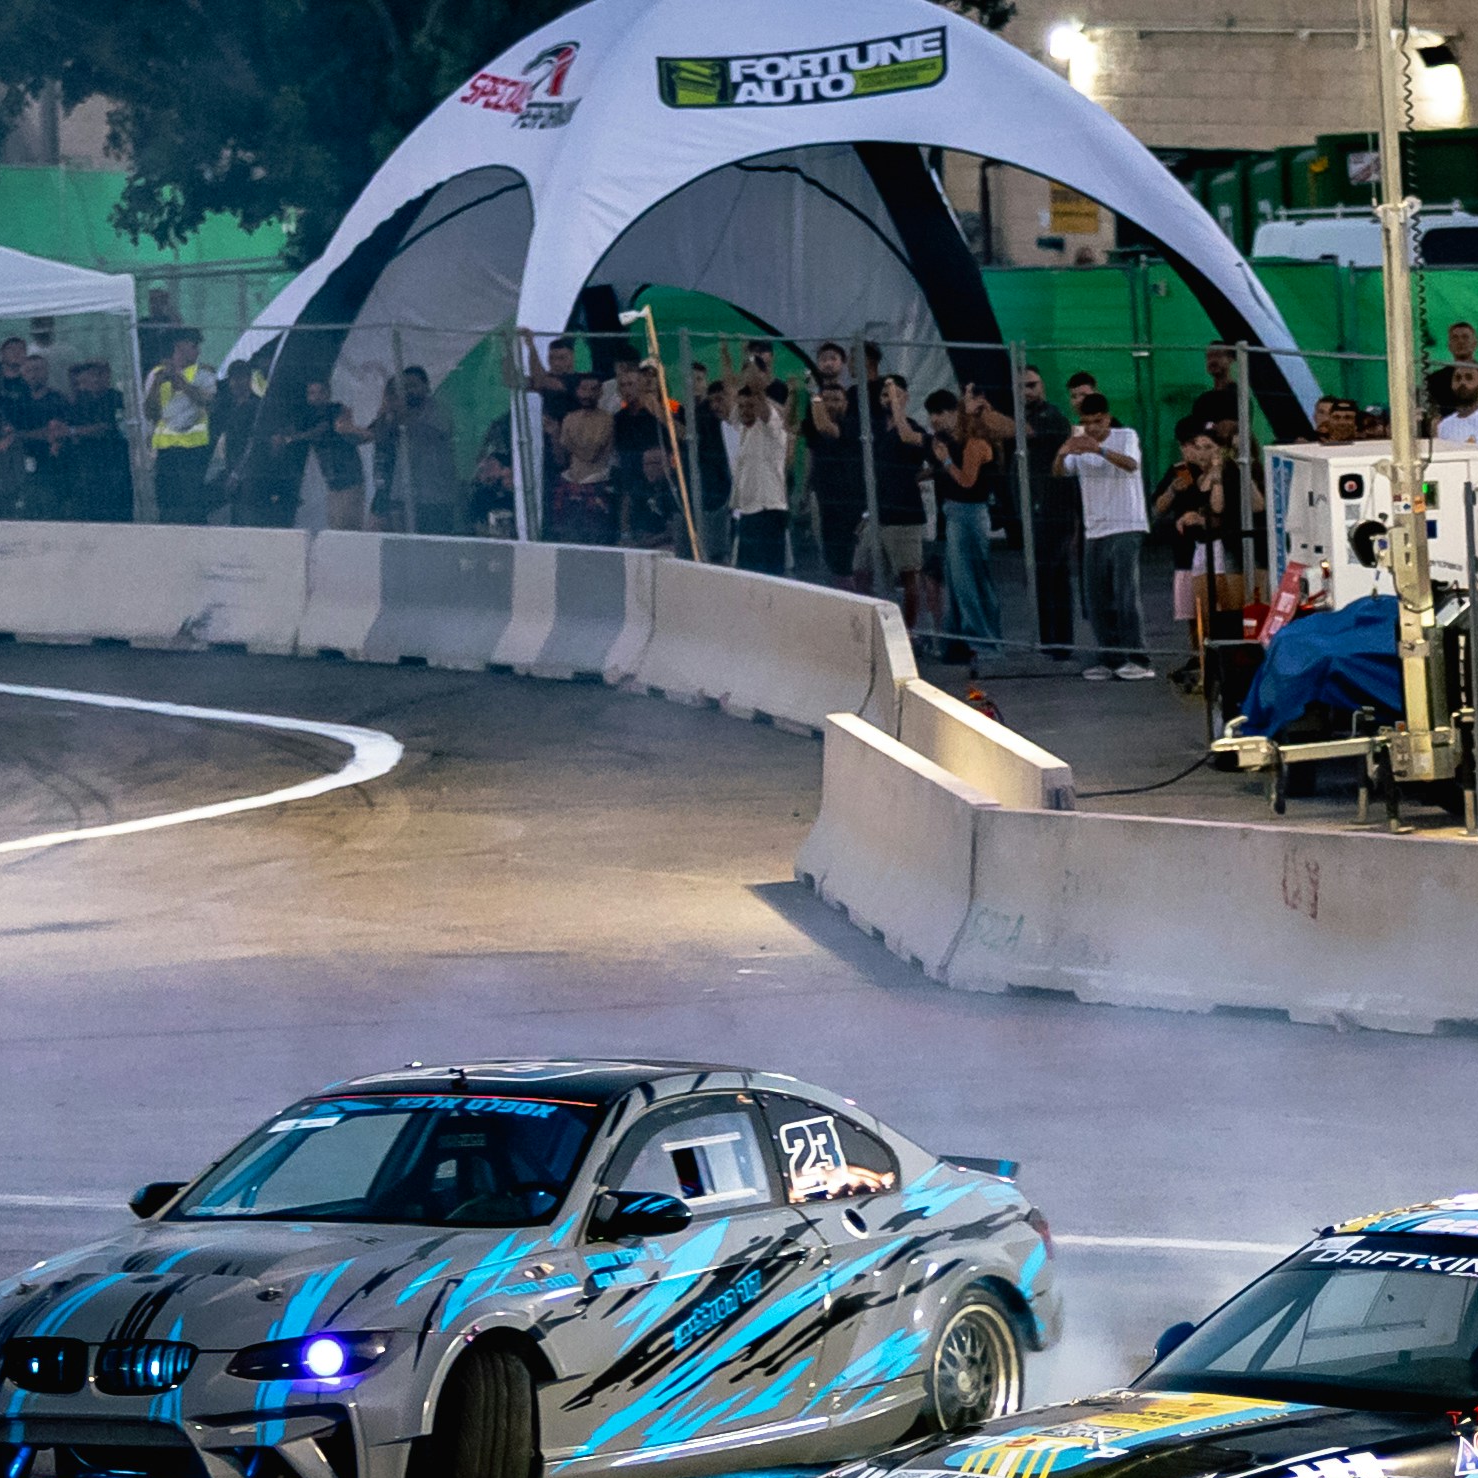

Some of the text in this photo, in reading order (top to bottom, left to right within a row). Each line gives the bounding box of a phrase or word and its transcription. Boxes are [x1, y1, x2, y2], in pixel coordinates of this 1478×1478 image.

[729, 30, 942, 83] FORTUNE
[734, 72, 857, 104] AUTO
[779, 1115, 852, 1197] 23
